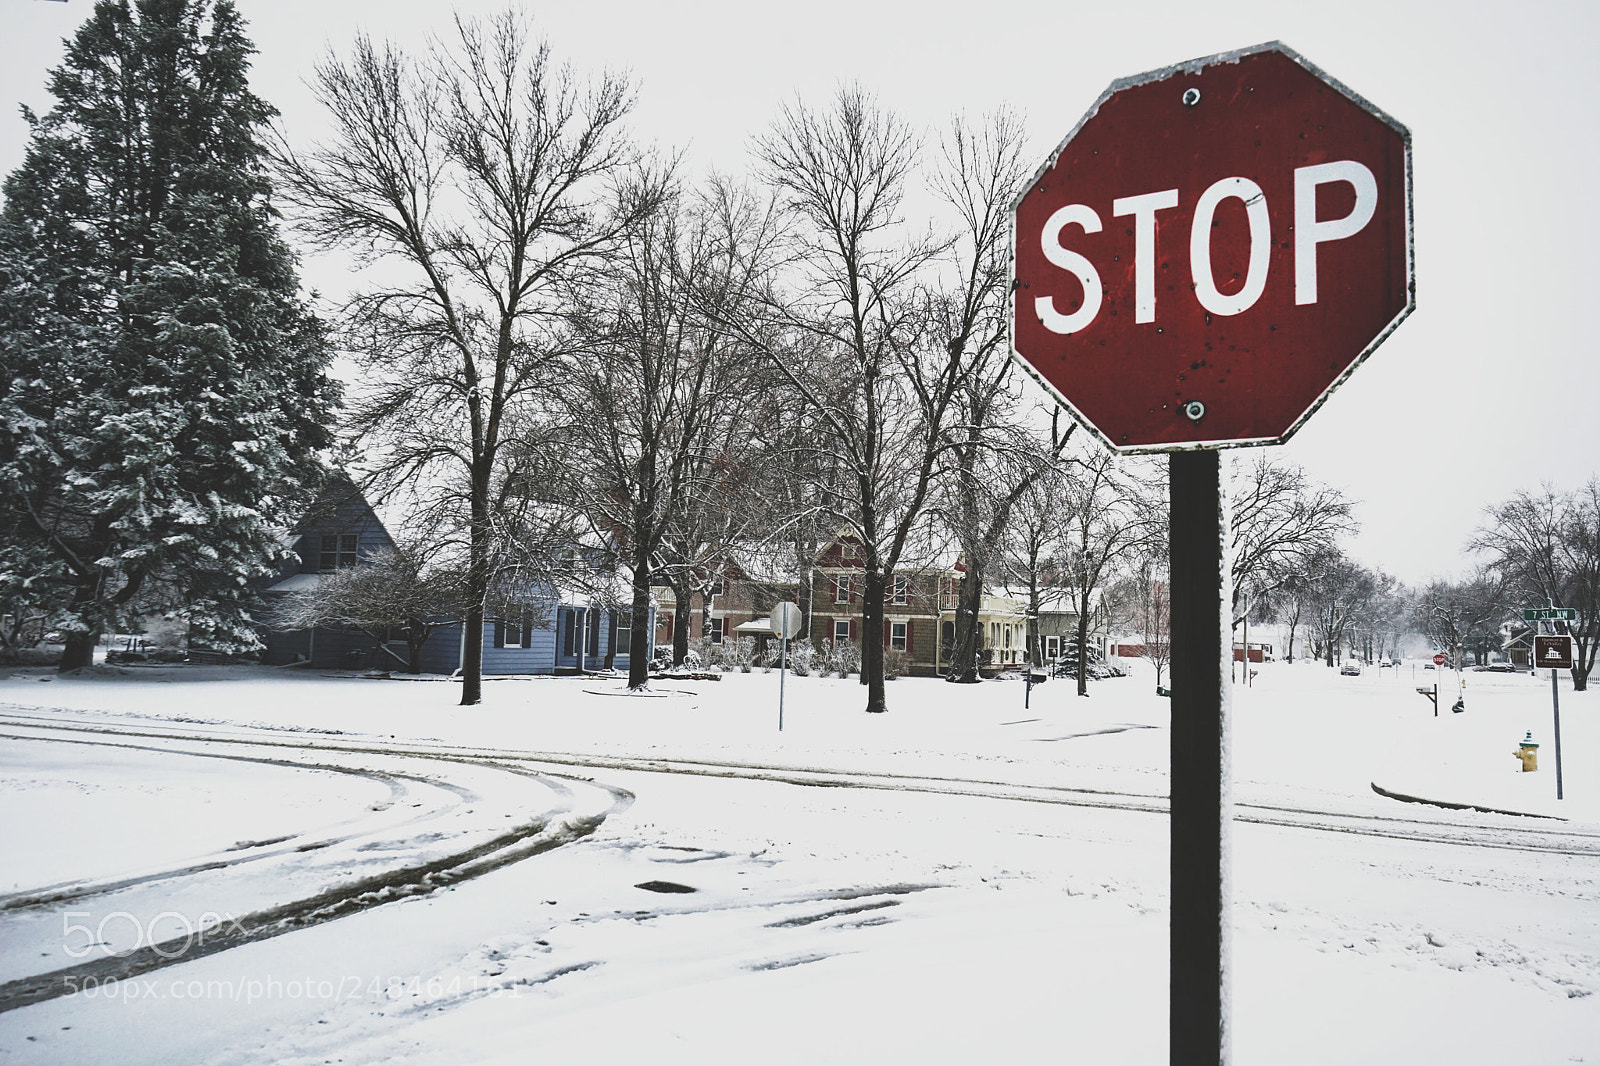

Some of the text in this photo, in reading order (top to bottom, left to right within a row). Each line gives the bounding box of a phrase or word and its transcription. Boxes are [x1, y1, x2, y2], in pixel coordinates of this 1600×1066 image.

[1035, 160, 1378, 335] STOP
[1532, 611, 1569, 619] 7 ST NW
